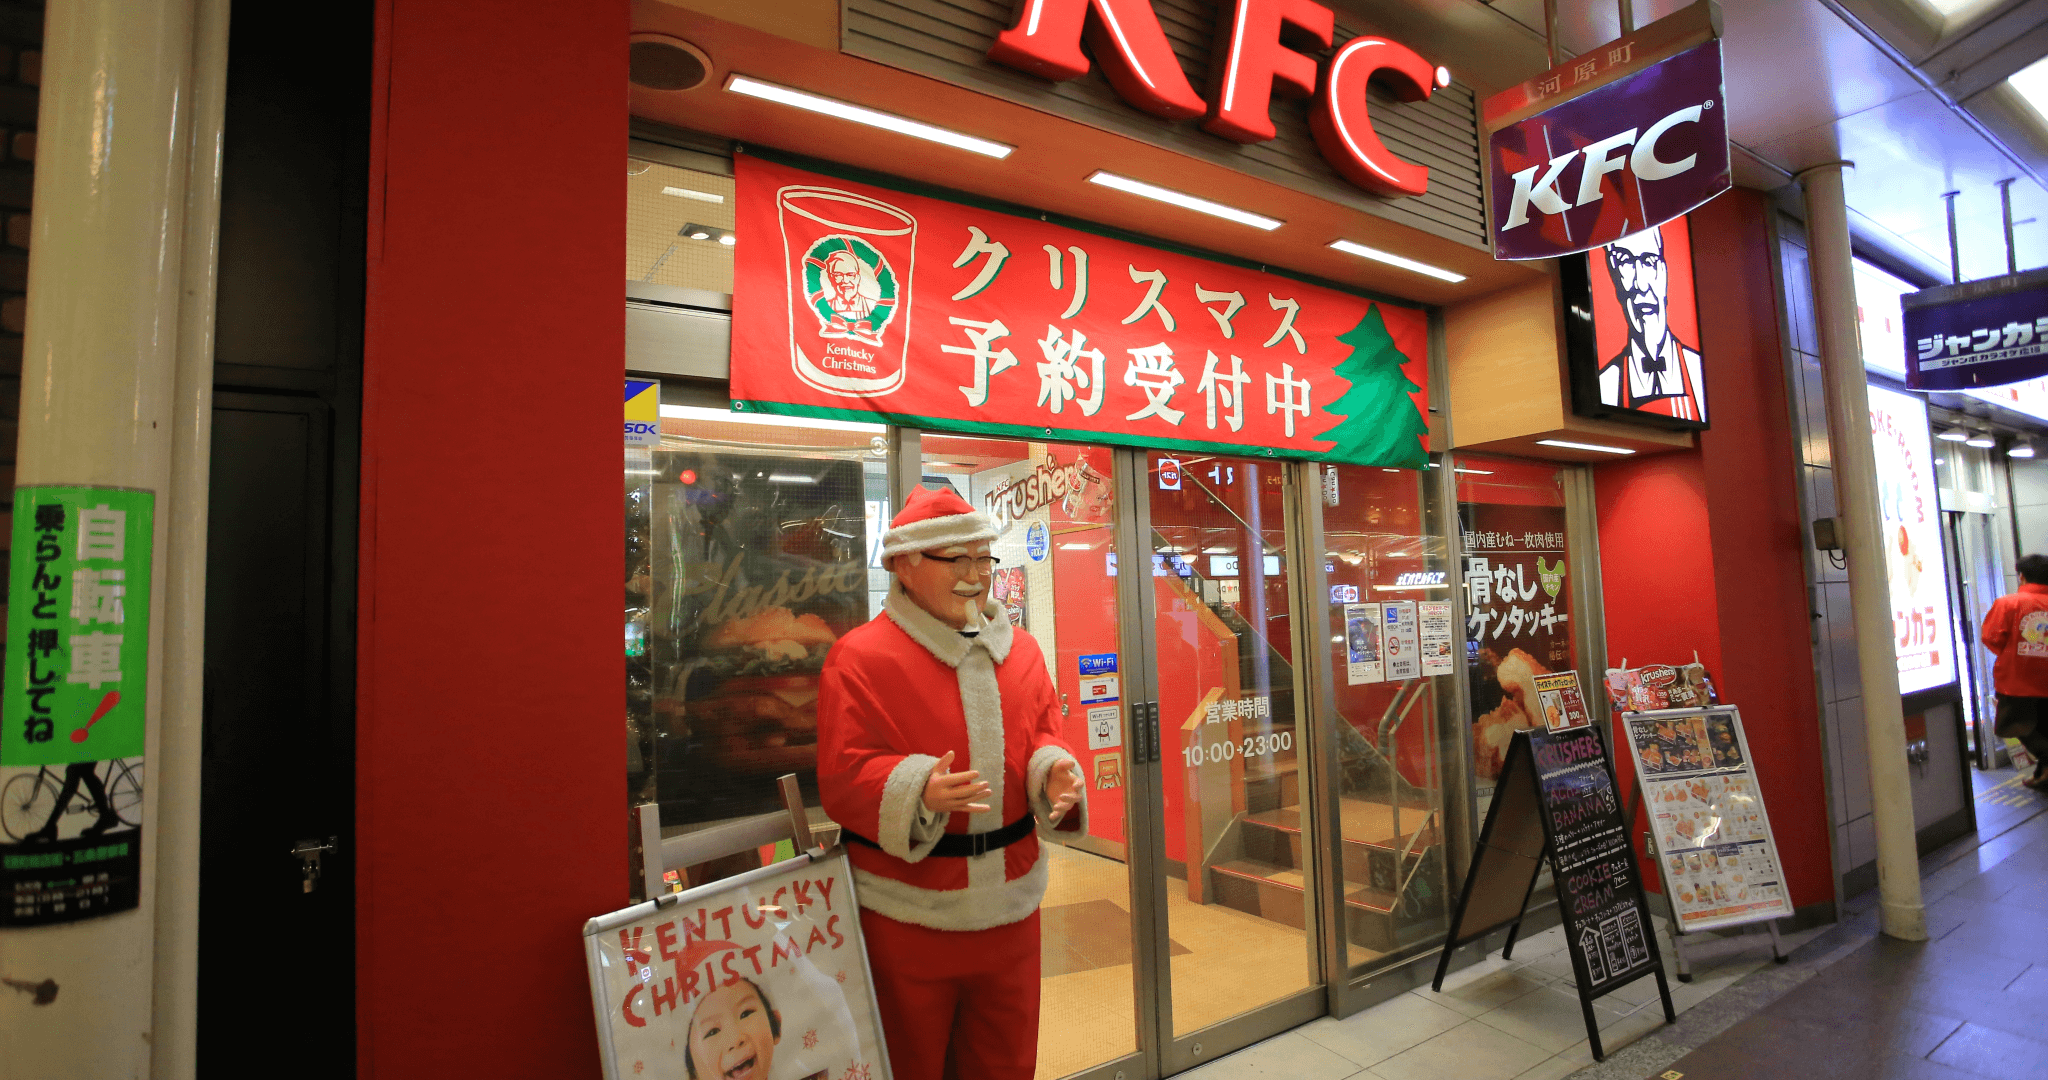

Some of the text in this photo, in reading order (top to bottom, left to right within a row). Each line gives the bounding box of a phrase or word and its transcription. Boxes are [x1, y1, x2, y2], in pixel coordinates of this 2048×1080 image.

[1537, 41, 1635, 99] 河原町
[1501, 104, 1703, 232] KFC
[951, 225, 1308, 356] クリスマス
[822, 356, 877, 375] Christmas
[826, 342, 875, 363] Kentucky
[940, 315, 1313, 438] 予約受付中
[1464, 530, 1564, 549] 国内産むね一枚肉使用
[1464, 557, 1538, 605] 骨なし
[1546, 583, 1560, 591] チキン
[1467, 603, 1569, 643] ケンタッキー
[1893, 606, 1937, 649] ンカラ
[1092, 657, 1114, 668] Wi-Fi
[1204, 696, 1270, 725] 営業時間
[1553, 796, 1605, 831] BANANA
[1568, 862, 1612, 894] COOKIE
[1573, 883, 1615, 915] CREAM
[618, 876, 835, 977] KENTUCKY
[622, 914, 845, 1028] CHRISTMAS
